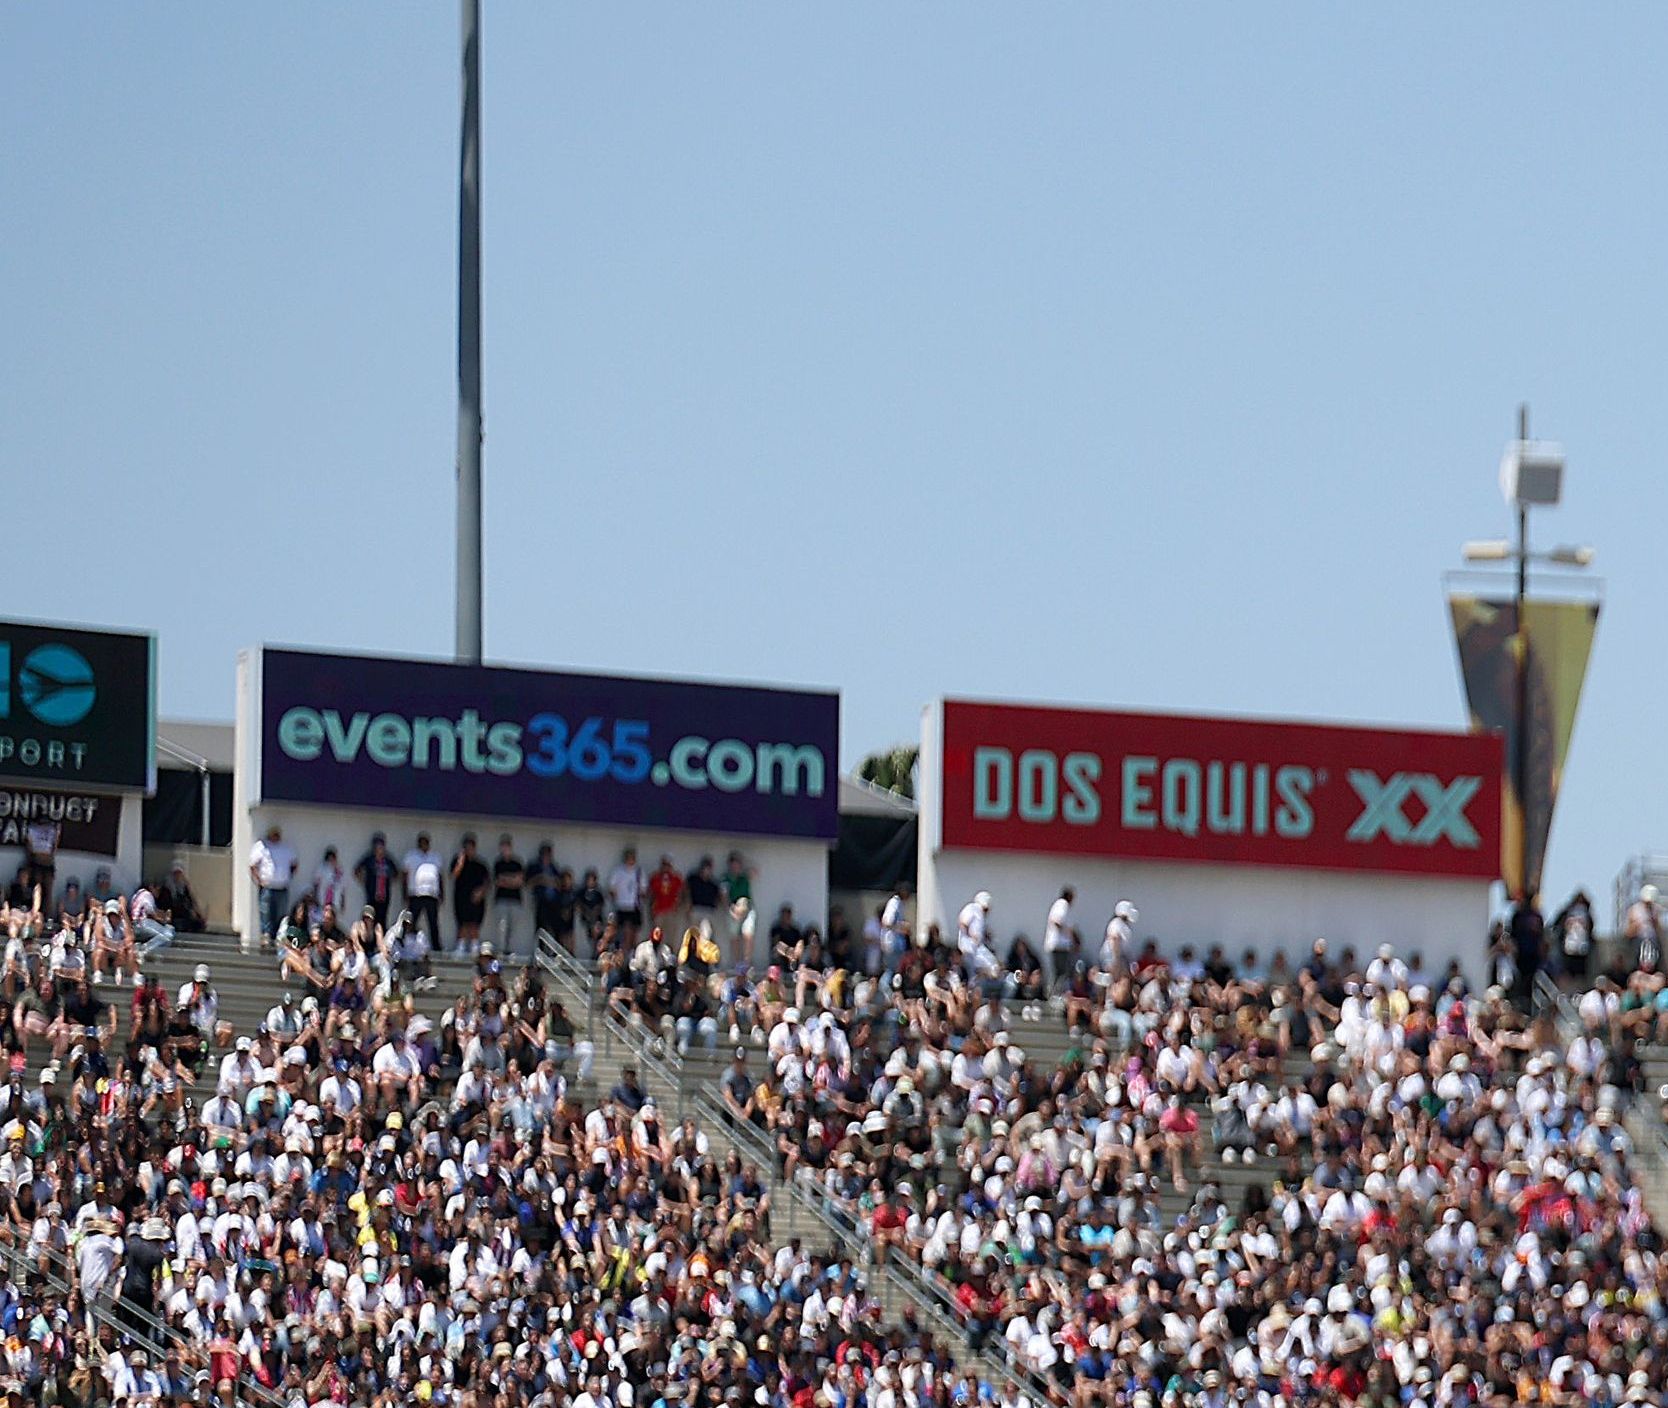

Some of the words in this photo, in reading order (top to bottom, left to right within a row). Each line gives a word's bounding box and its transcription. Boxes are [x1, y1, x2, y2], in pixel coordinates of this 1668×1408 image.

[277, 704, 827, 797] events365.com
[972, 745, 1100, 823] DOS
[1121, 756, 1315, 837] EQUIS
[1345, 770, 1483, 848] XX
